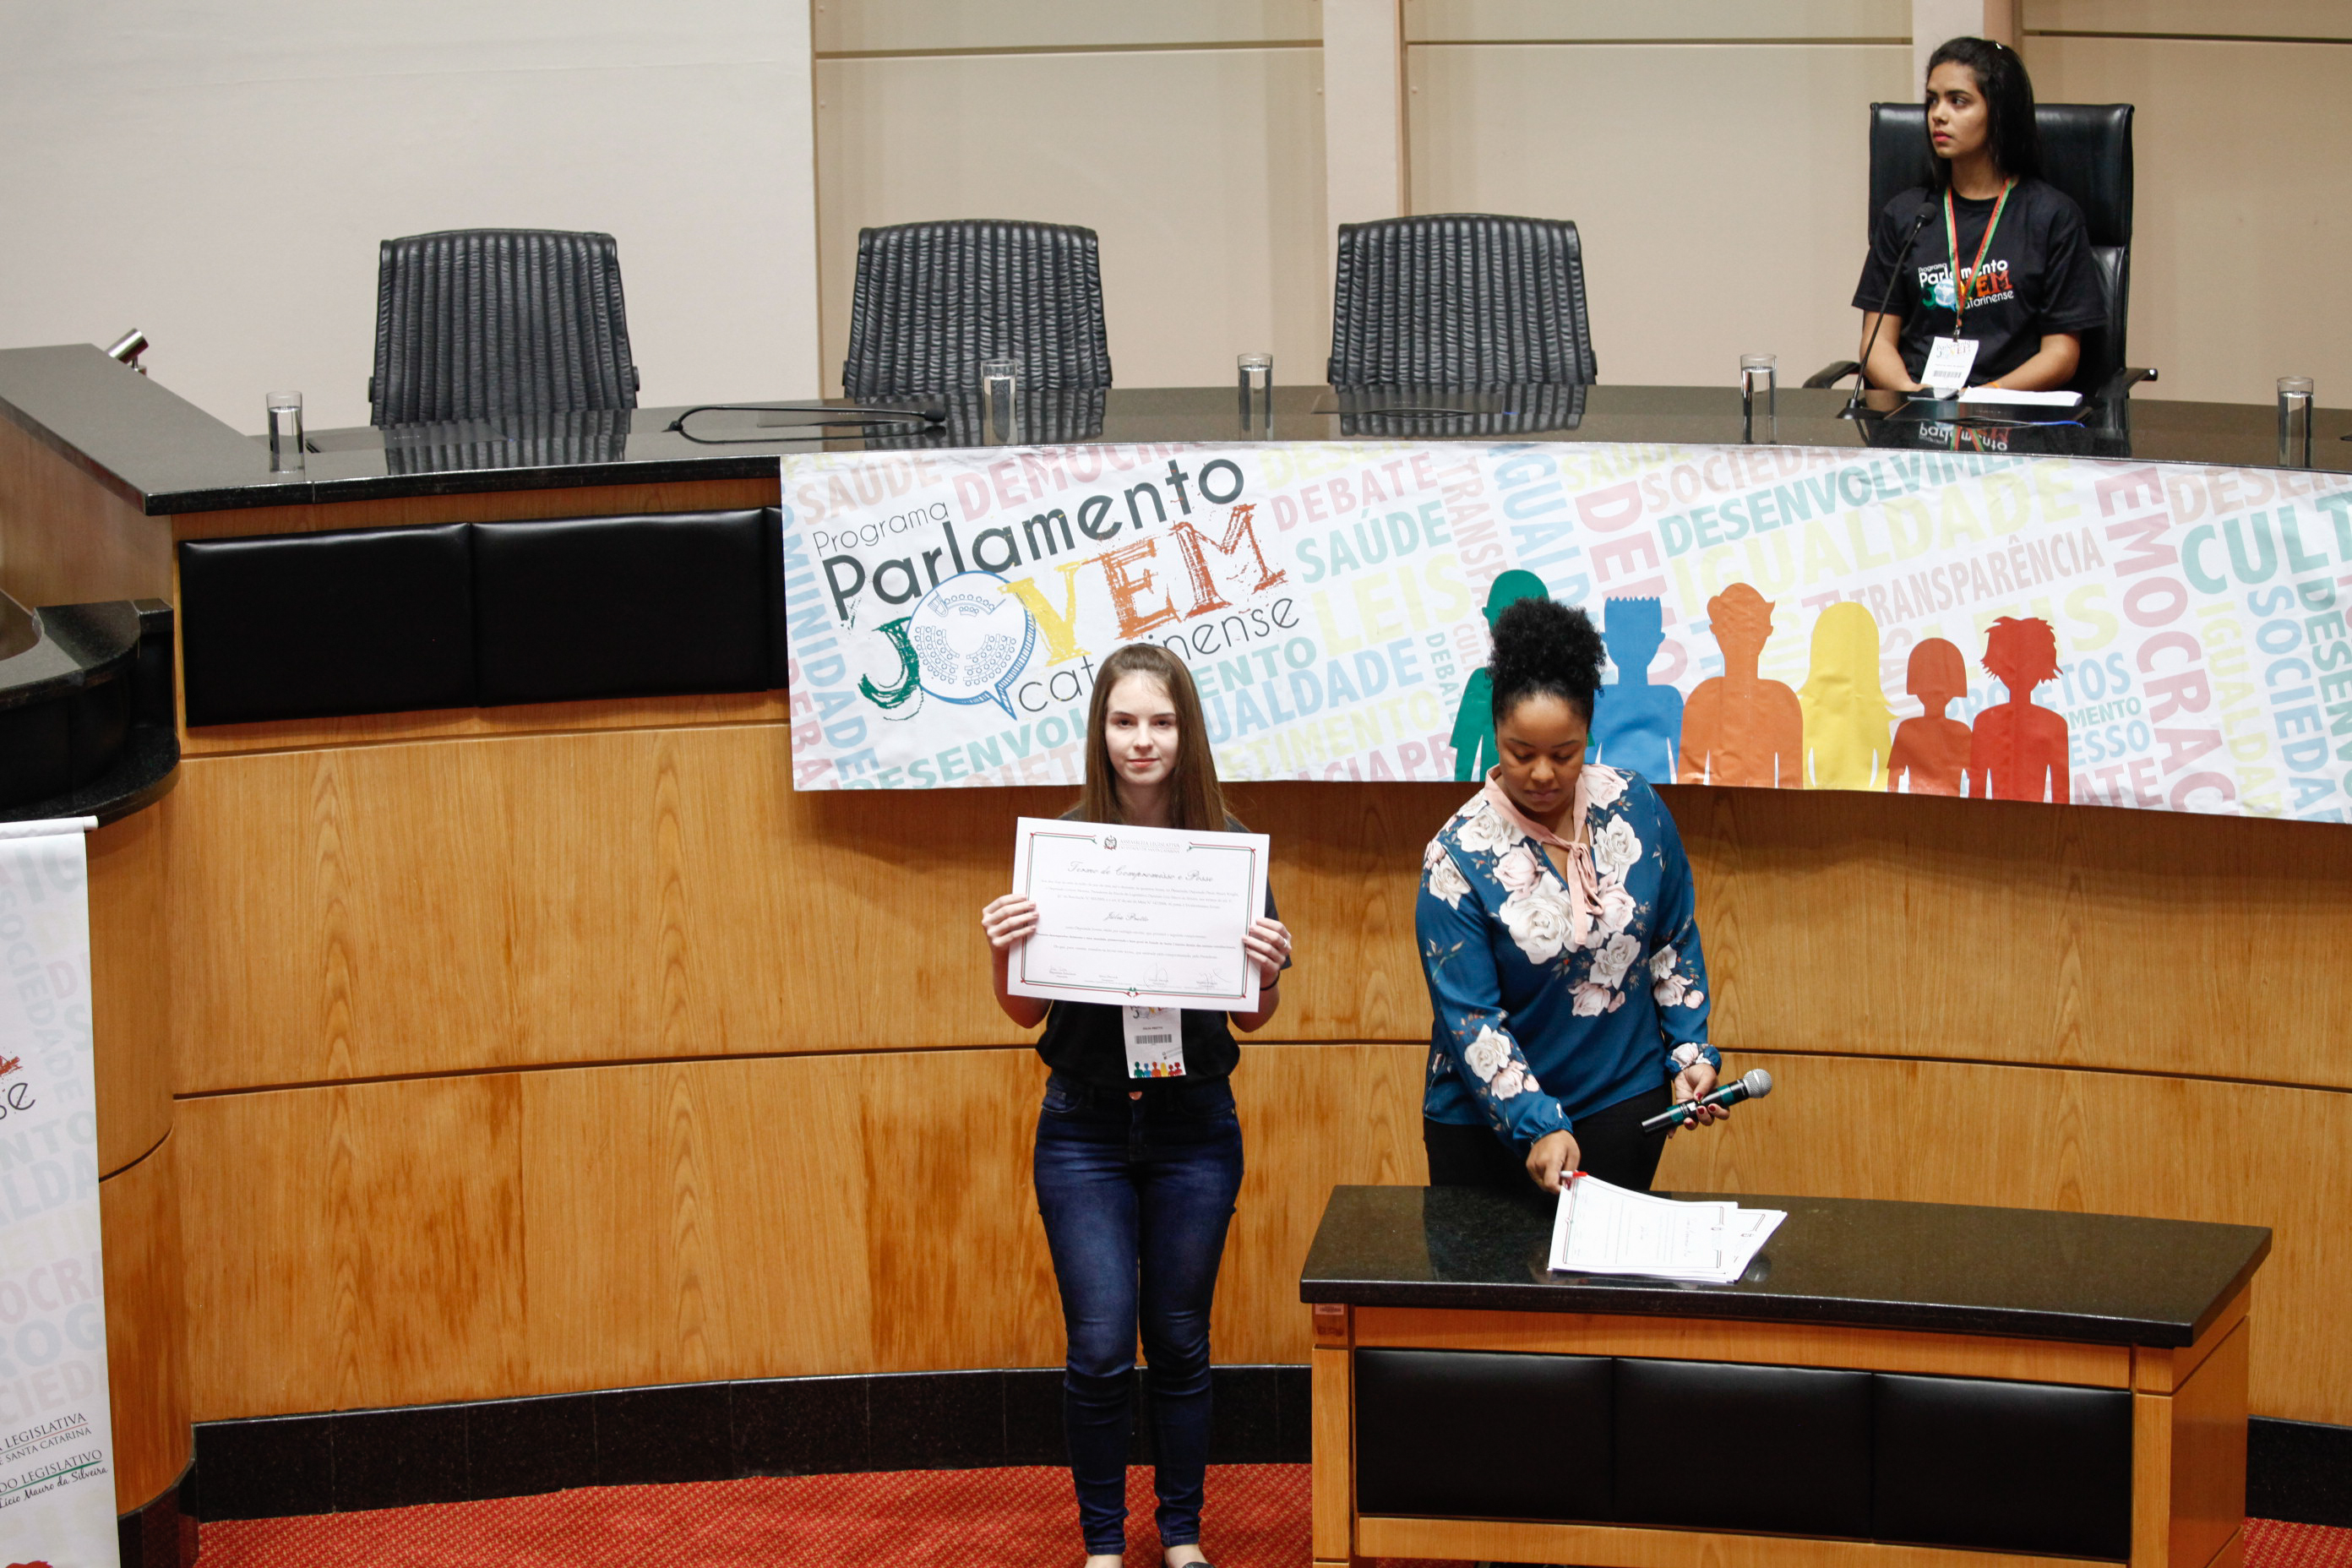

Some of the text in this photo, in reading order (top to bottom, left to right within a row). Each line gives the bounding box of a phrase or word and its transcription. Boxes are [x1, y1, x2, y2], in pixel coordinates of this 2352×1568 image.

[1271, 451, 1439, 532] DEBATE
[812, 502, 950, 558] Programa
[822, 459, 1244, 623] Parlamento
[1295, 500, 1452, 583] SAÚDE
[1309, 553, 1471, 657] LEIS
[1849, 534, 2104, 628] TRANSPARÊNCIA
[5, 1413, 86, 1448] LEGISLATIVA
[6, 1444, 39, 1463] SANTA
[40, 1427, 92, 1450] CATARINA
[21, 1449, 102, 1484] LEGISLATIVO
[24, 1480, 54, 1501] Mauro
[57, 1473, 69, 1487] da
[71, 1465, 108, 1484] Silveira
